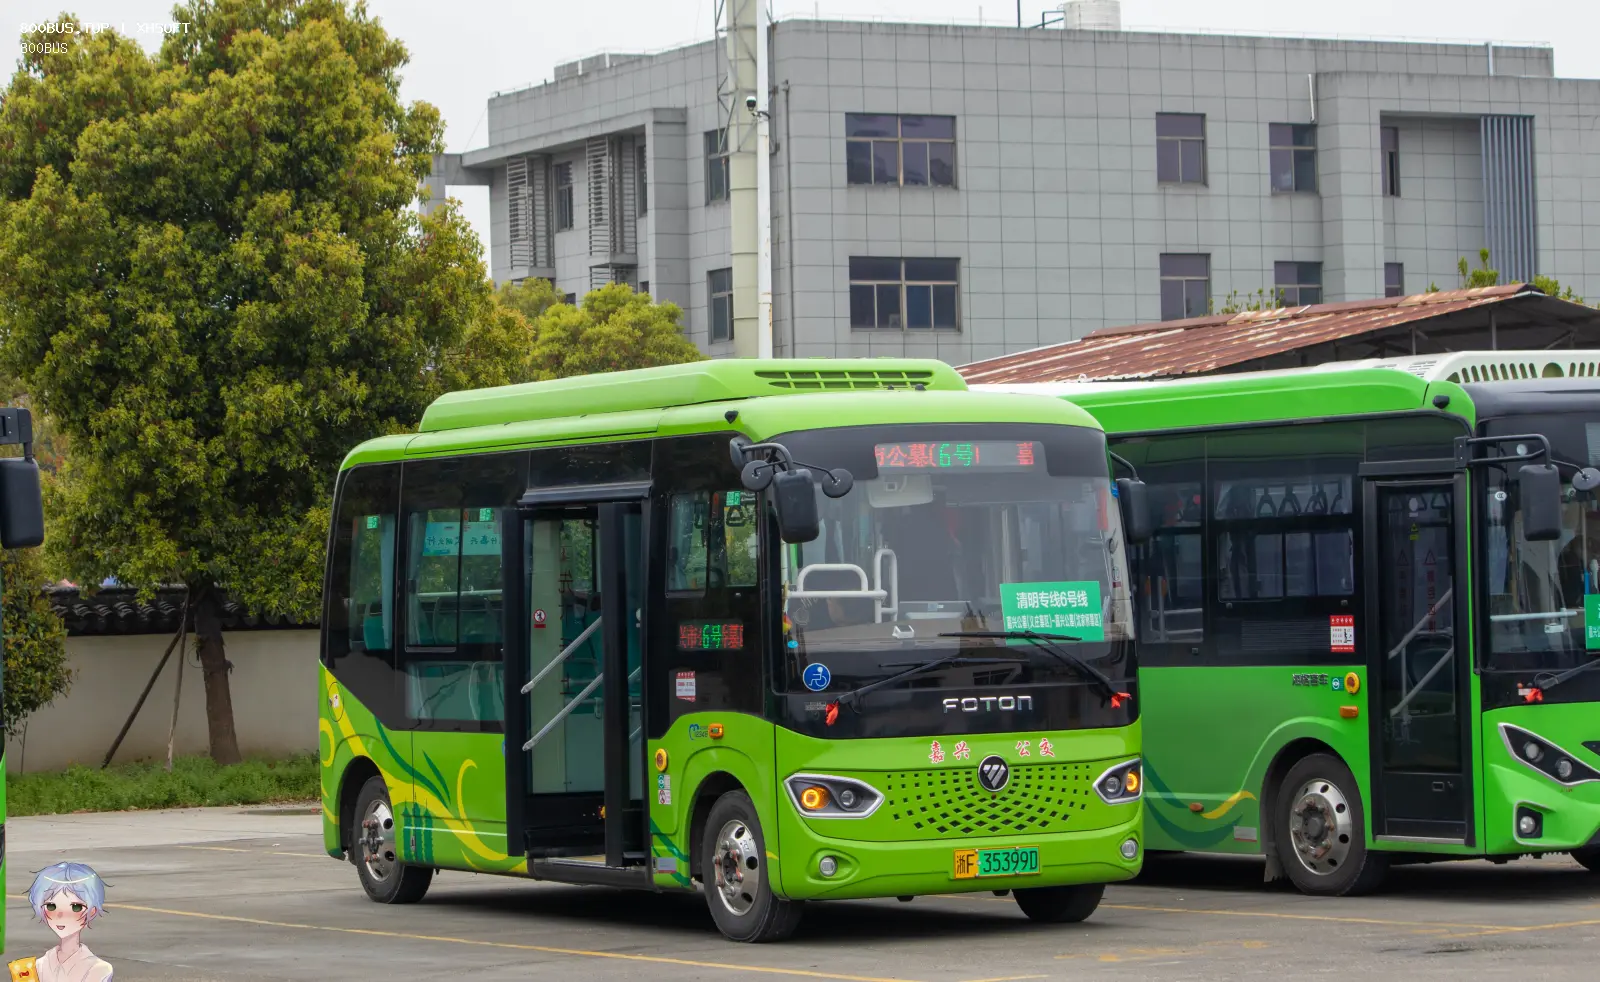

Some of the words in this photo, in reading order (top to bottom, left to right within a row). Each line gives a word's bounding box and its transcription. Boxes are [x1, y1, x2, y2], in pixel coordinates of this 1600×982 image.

[1016, 590, 1089, 609] 清明专线6号线
[942, 695, 1033, 714] FOTON
[928, 740, 971, 764] 嘉兴
[1015, 737, 1056, 758] 公交
[982, 850, 1038, 873] 35399D
